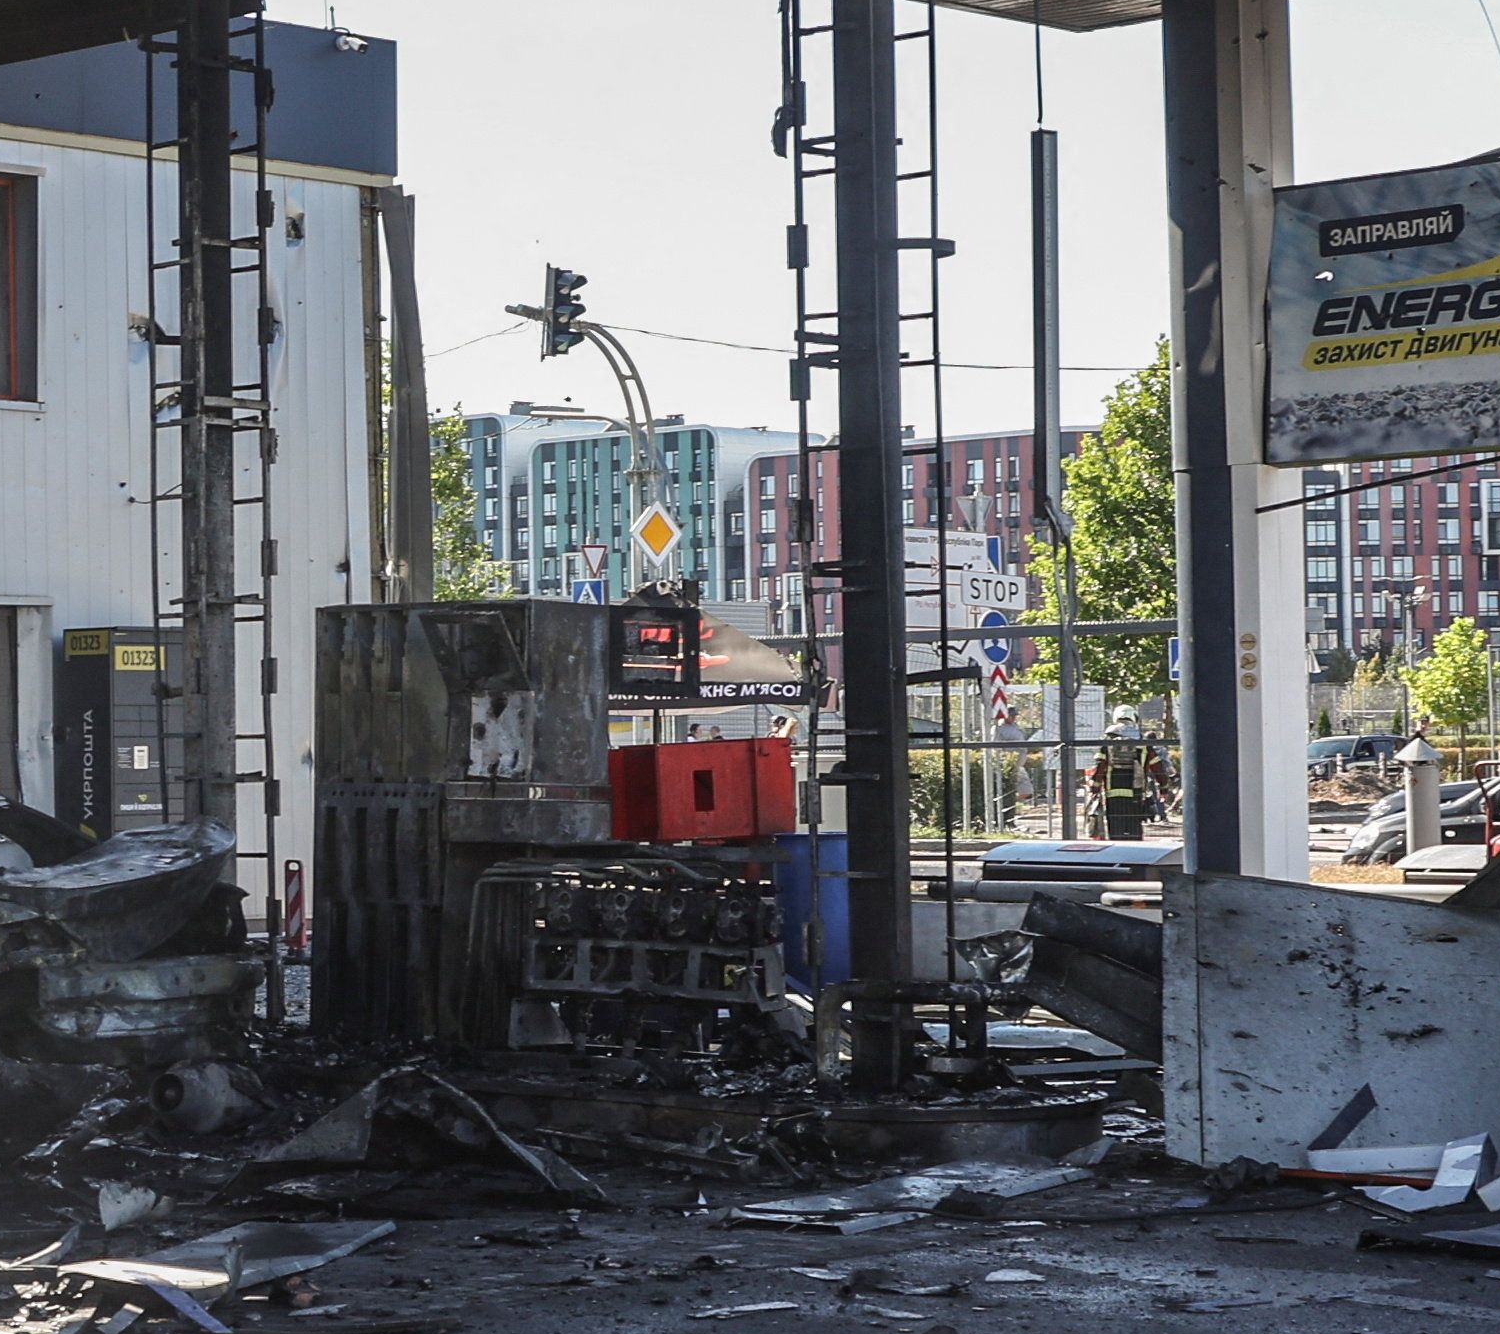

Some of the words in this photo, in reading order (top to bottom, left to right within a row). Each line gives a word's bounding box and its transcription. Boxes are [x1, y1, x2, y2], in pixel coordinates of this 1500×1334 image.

[1329, 210, 1455, 248] ЗАПРАВЛЯЙ
[1313, 331, 1402, 366] захист
[970, 578, 1018, 602] STOP
[70, 634, 101, 652] 01323
[121, 650, 157, 666] 01323
[740, 683, 802, 698] М'ЯСО!
[82, 709, 94, 820] УКРПОШТА
